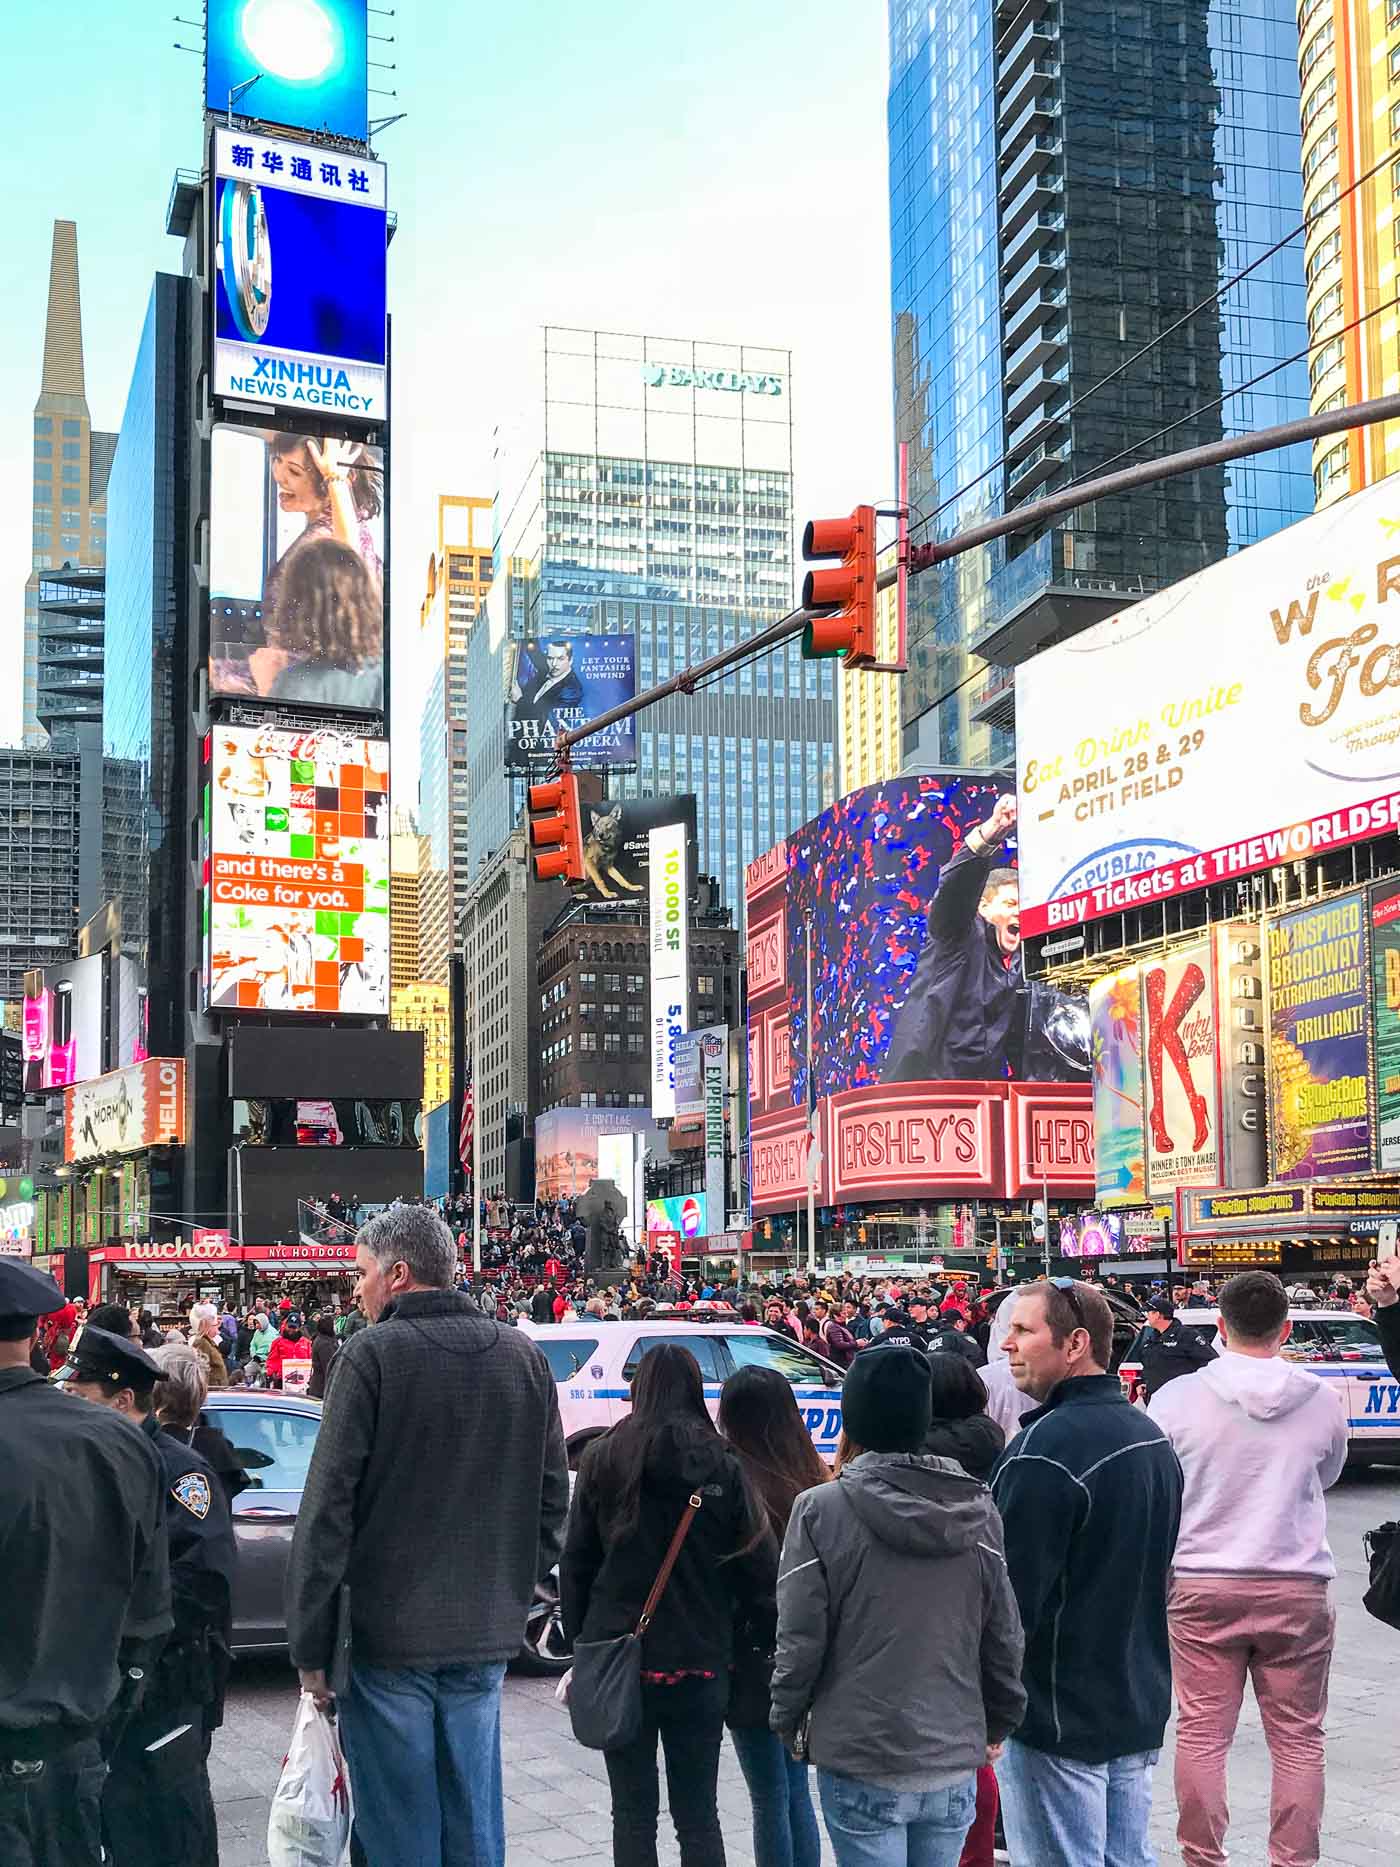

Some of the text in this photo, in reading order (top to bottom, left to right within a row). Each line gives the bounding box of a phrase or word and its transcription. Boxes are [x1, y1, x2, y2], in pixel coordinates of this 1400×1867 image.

[231, 143, 370, 193] 新华通讯社
[252, 356, 351, 391] XINHUA
[668, 367, 783, 396] BARCLAYS
[230, 375, 373, 412] NEWS AGENCY
[1306, 571, 1331, 591] the
[581, 664, 631, 672] FANTASIES
[603, 656, 630, 664] YOUR
[586, 672, 625, 680] UNWIND
[553, 707, 585, 719] THE
[508, 717, 633, 740] PHANM
[1022, 682, 1243, 793] Eat Drink Unite
[519, 737, 538, 749] OF
[574, 735, 621, 749] OPERA
[1058, 729, 1205, 804] APRIL 28 & 29
[1074, 766, 1183, 821] CITI FIELD
[216, 857, 344, 882] and there's a
[1058, 851, 1156, 898] EPUBLIC
[216, 882, 349, 909] Coke for you.
[1047, 896, 1088, 926] Buy
[1093, 868, 1175, 912] Tickets
[1180, 855, 1207, 886] at
[666, 927, 680, 951] SF
[1292, 902, 1359, 951] INSPIRED
[1271, 933, 1360, 989] BROADWAY
[707, 1045, 720, 1053] NFL
[1187, 1035, 1213, 1059] Boots
[1235, 940, 1258, 1132] PALACE
[94, 1099, 133, 1125] MORMON
[159, 1062, 177, 1141] HELLO!
[705, 1066, 723, 1159] EXPERIENCE
[1034, 1118, 1094, 1165] HER
[1150, 1169, 1176, 1179] INCLUDING
[1177, 1167, 1192, 1176] BEST
[1180, 1154, 1196, 1168] TONY
[124, 1235, 228, 1258] nuchas
[269, 1247, 350, 1257] NYC HOTDOGS
[888, 1336, 911, 1344] NYPD
[587, 1389, 592, 1399] 2
[1365, 1385, 1400, 1413] NY
